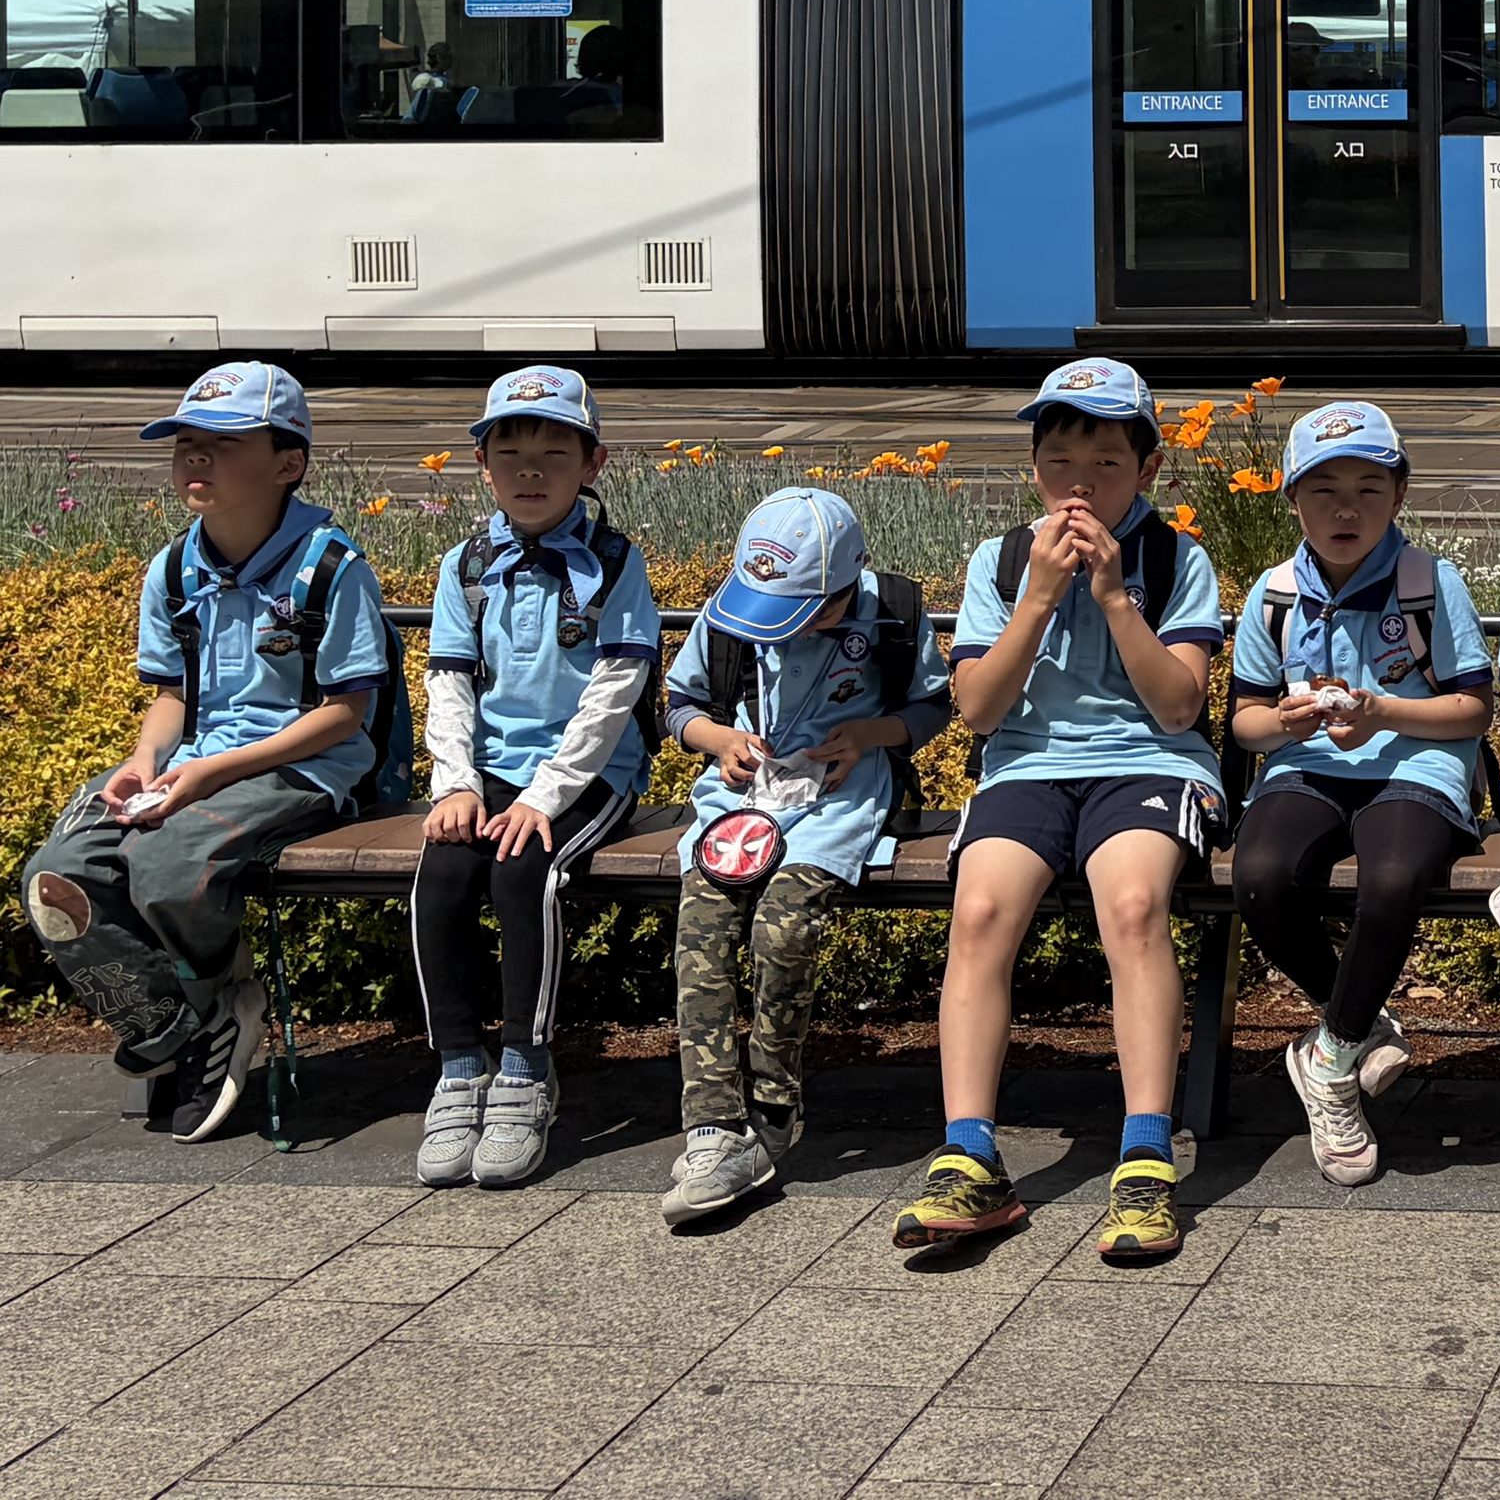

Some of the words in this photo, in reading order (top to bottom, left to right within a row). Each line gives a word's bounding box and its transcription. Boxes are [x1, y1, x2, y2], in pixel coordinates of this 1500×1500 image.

[1142, 95, 1223, 111] ENTRANCE
[1308, 94, 1389, 109] ENTRANCE
[1168, 143, 1198, 159] 入口
[1334, 142, 1364, 158] 入口
